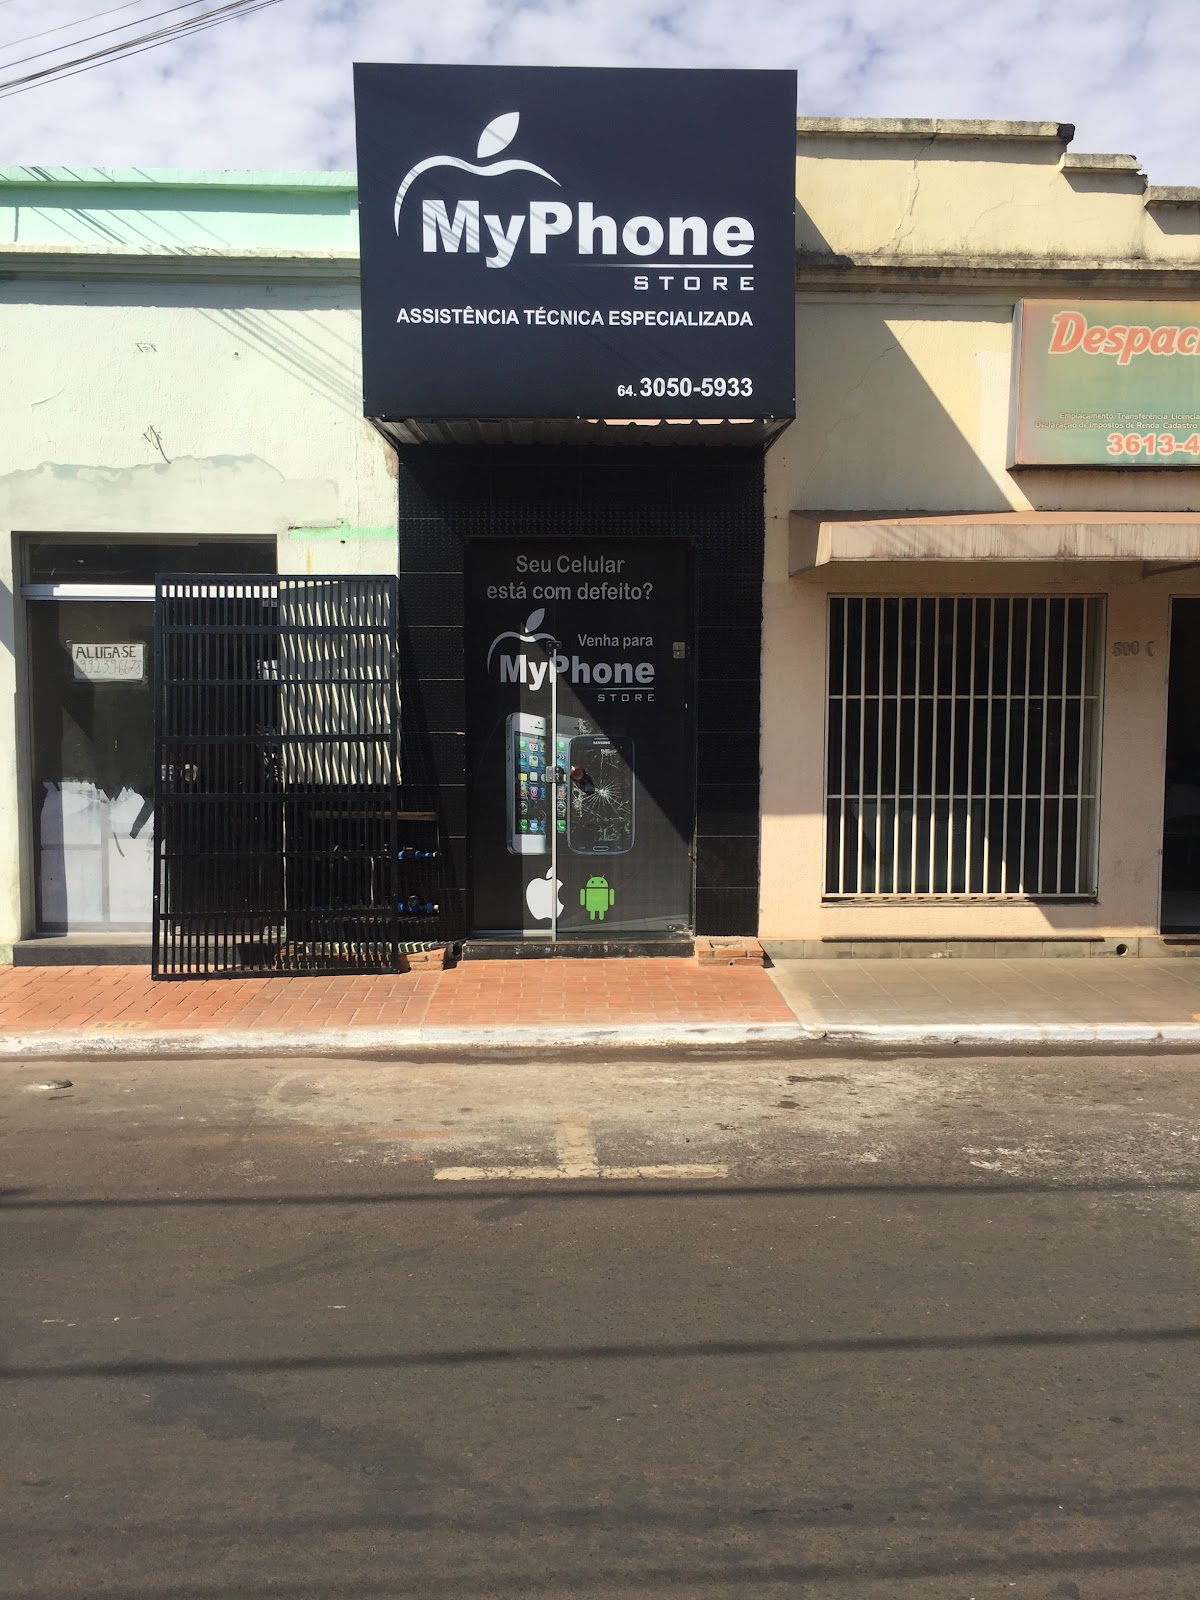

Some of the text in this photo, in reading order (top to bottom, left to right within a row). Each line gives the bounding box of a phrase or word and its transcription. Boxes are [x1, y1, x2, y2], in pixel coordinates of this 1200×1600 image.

[422, 200, 755, 269] MyPhone
[633, 276, 755, 291] STORE
[396, 305, 753, 327] ASSISTÊNCIA TÉCNICA ESPECIALIZADA
[1048, 311, 1200, 366] Despac
[617, 377, 753, 398] 64. 3050-5933
[1079, 421, 1088, 429] de
[1089, 421, 1124, 430] Impostos
[516, 555, 625, 573] Seu Celular
[486, 581, 654, 600] está com defeito?
[577, 633, 654, 649] Venha para
[76, 645, 136, 659] ALUGA-SE
[500, 654, 656, 691] MyPhone
[597, 693, 655, 702] STORE
